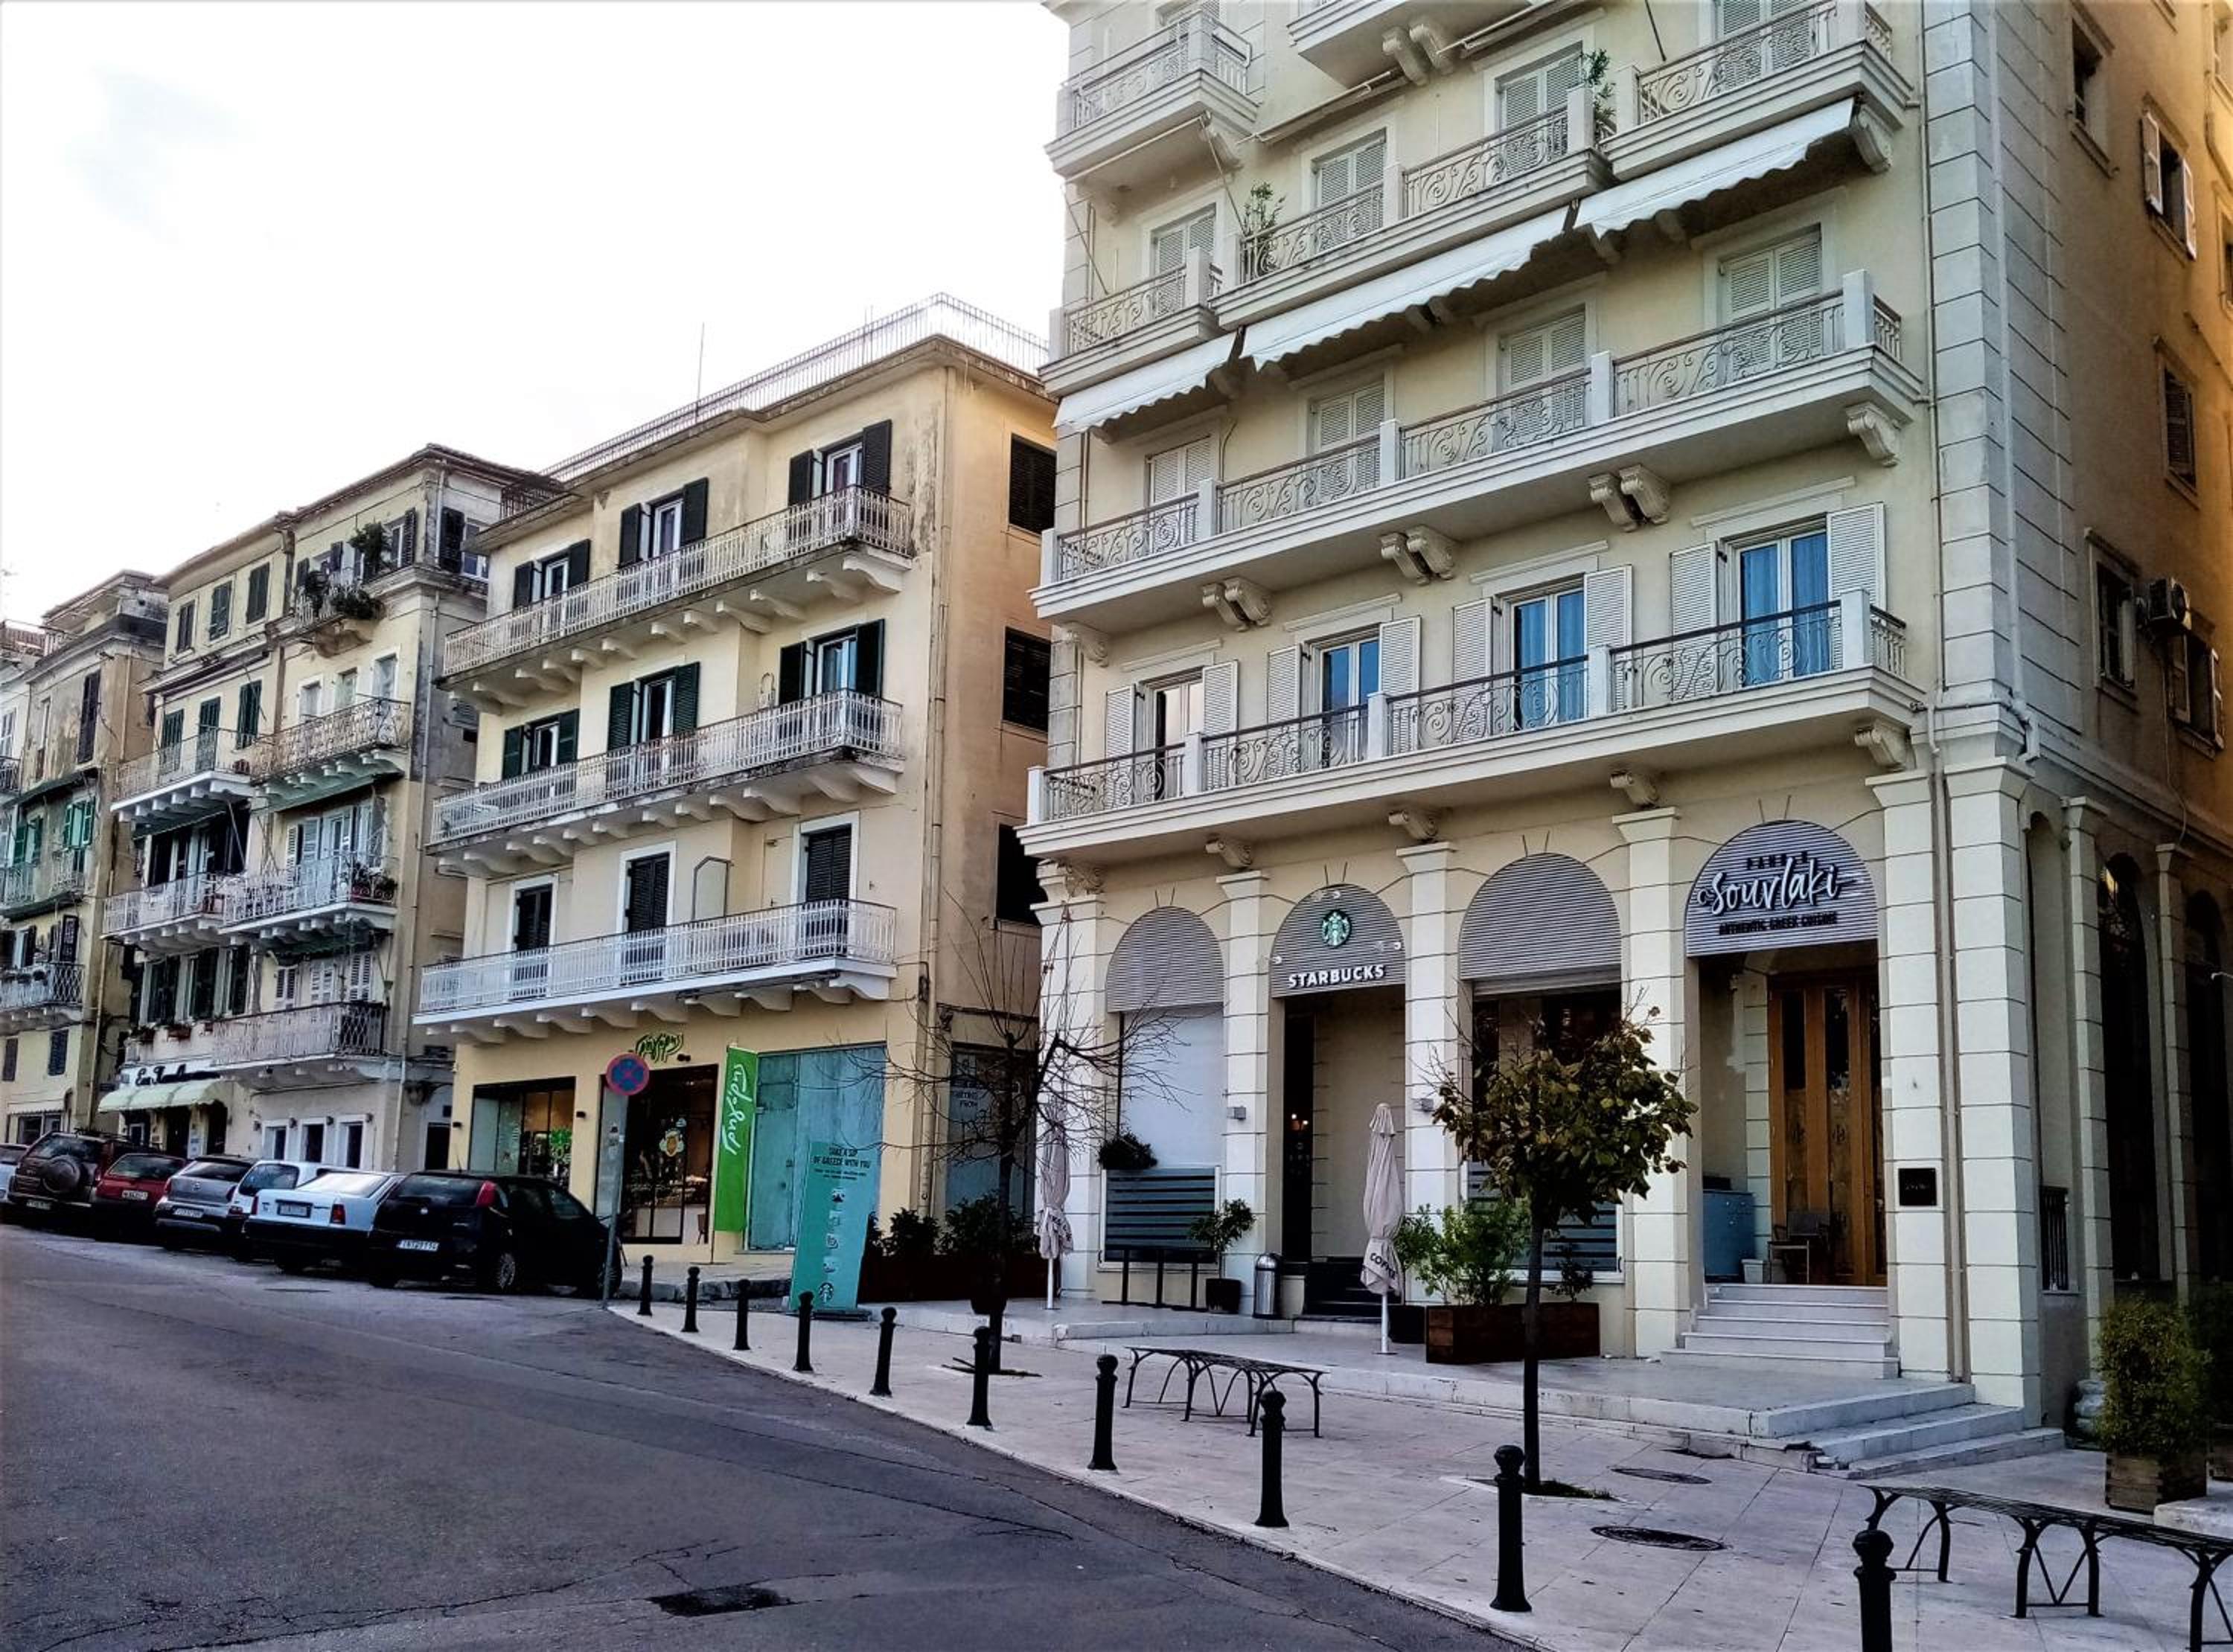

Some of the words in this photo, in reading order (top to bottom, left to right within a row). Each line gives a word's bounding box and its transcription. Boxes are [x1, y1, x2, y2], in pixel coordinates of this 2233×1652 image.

[1711, 857, 1839, 915] Souvlaki
[1770, 915, 1798, 930] GREEK
[1288, 964, 1385, 988] STARBUCKS
